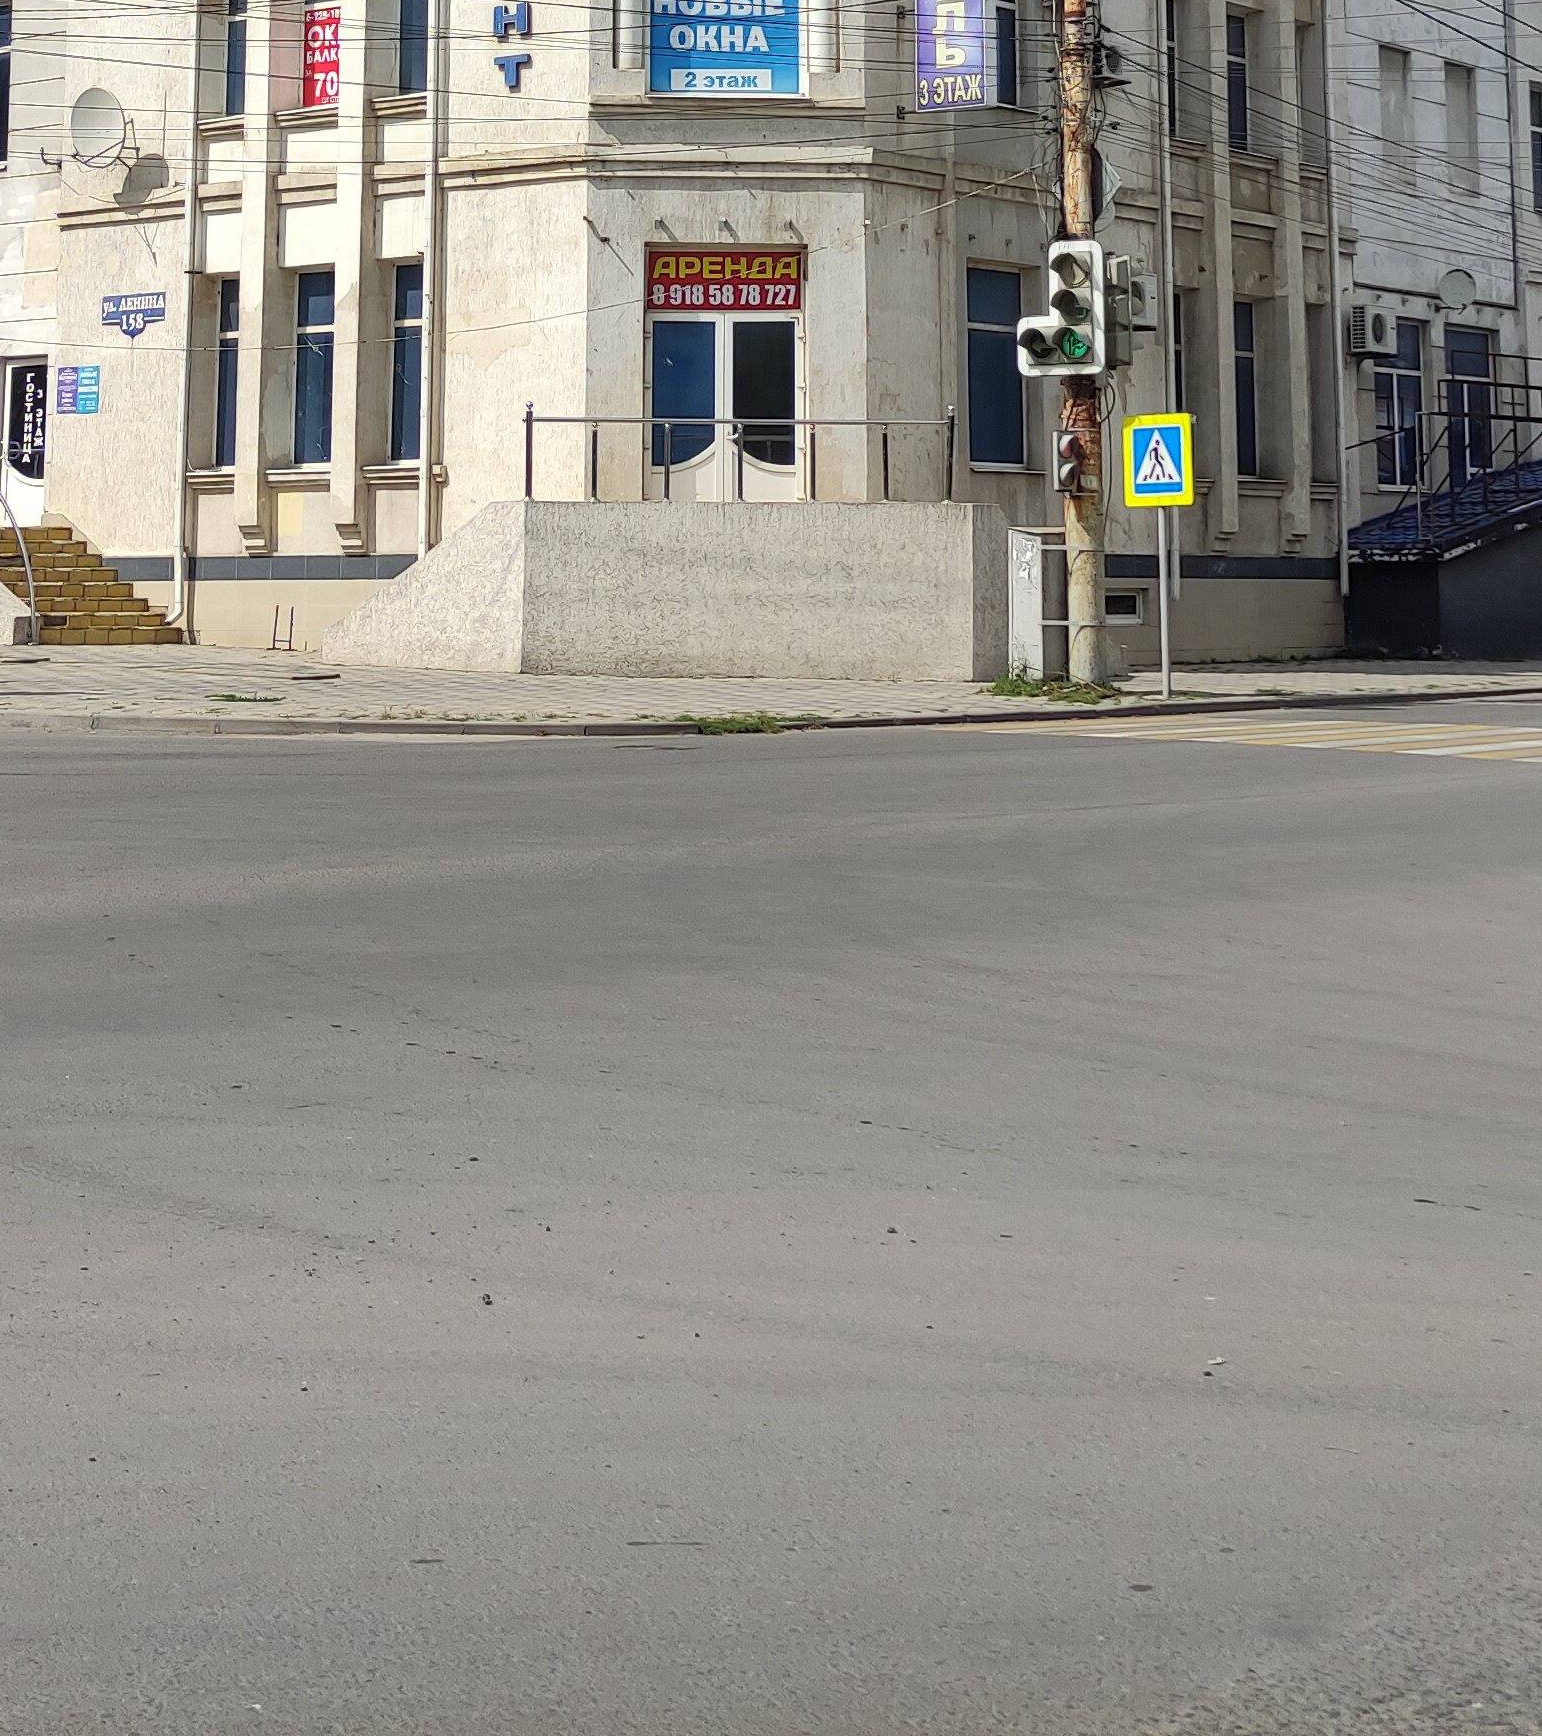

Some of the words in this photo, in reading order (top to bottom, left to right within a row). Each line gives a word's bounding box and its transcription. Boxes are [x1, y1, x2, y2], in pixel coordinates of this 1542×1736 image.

[308, 24, 339, 48] ОК
[669, 25, 770, 52] ОКНА
[306, 48, 339, 65] БАЛК
[684, 71, 697, 88] 2
[703, 75, 758, 88] этаж
[919, 79, 929, 106] 3
[933, 74, 982, 105] ЭТАЖ
[652, 256, 798, 280] АРЕНДА
[119, 295, 164, 311] ЛЕНИНА
[652, 284, 665, 305] 8
[669, 284, 704, 305] 918
[709, 284, 734, 305] 58
[738, 284, 760, 305] 78
[765, 284, 796, 305] 727
[121, 312, 144, 330] 158
[22, 372, 35, 463] ГОСТИНИЦА
[33, 408, 44, 447] ЭТАЖ
